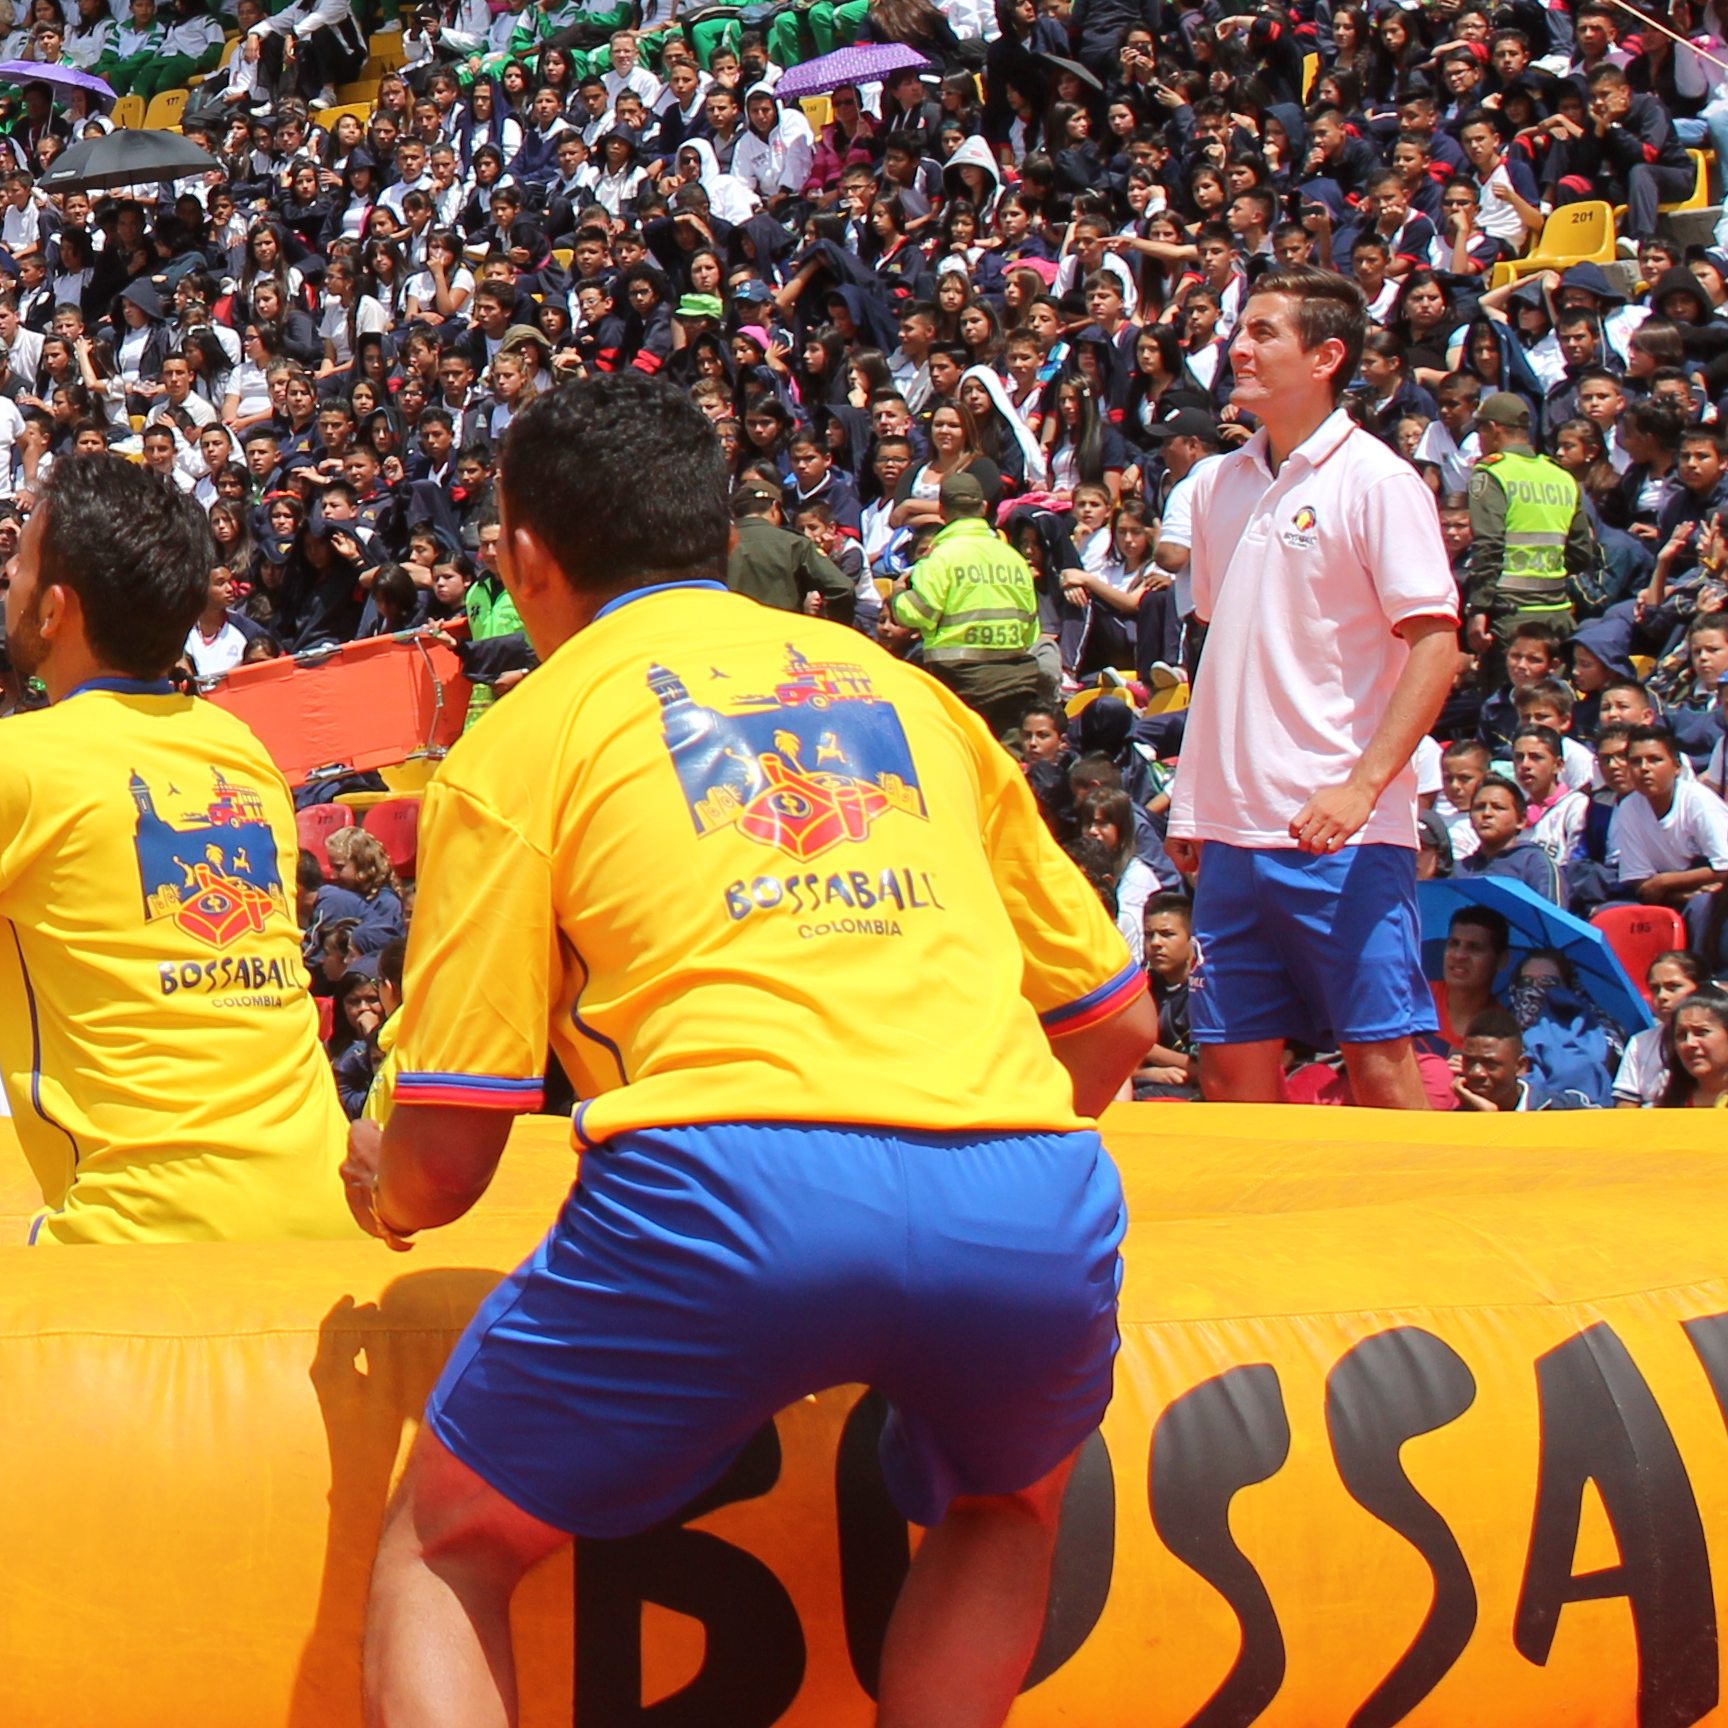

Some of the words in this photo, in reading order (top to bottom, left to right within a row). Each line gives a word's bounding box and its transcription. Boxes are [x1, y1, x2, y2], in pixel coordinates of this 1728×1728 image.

[166, 96, 180, 106] 177
[1571, 210, 1594, 224] 201
[1507, 480, 1574, 508] POLICIA
[954, 564, 1026, 585] POLICIA
[964, 623, 1020, 645] 6953
[724, 867, 945, 920] BOSSABALL
[798, 918, 904, 940] COLOMBIA
[158, 956, 304, 996] BOSSABALL
[211, 995, 283, 1009] COLOMBIA
